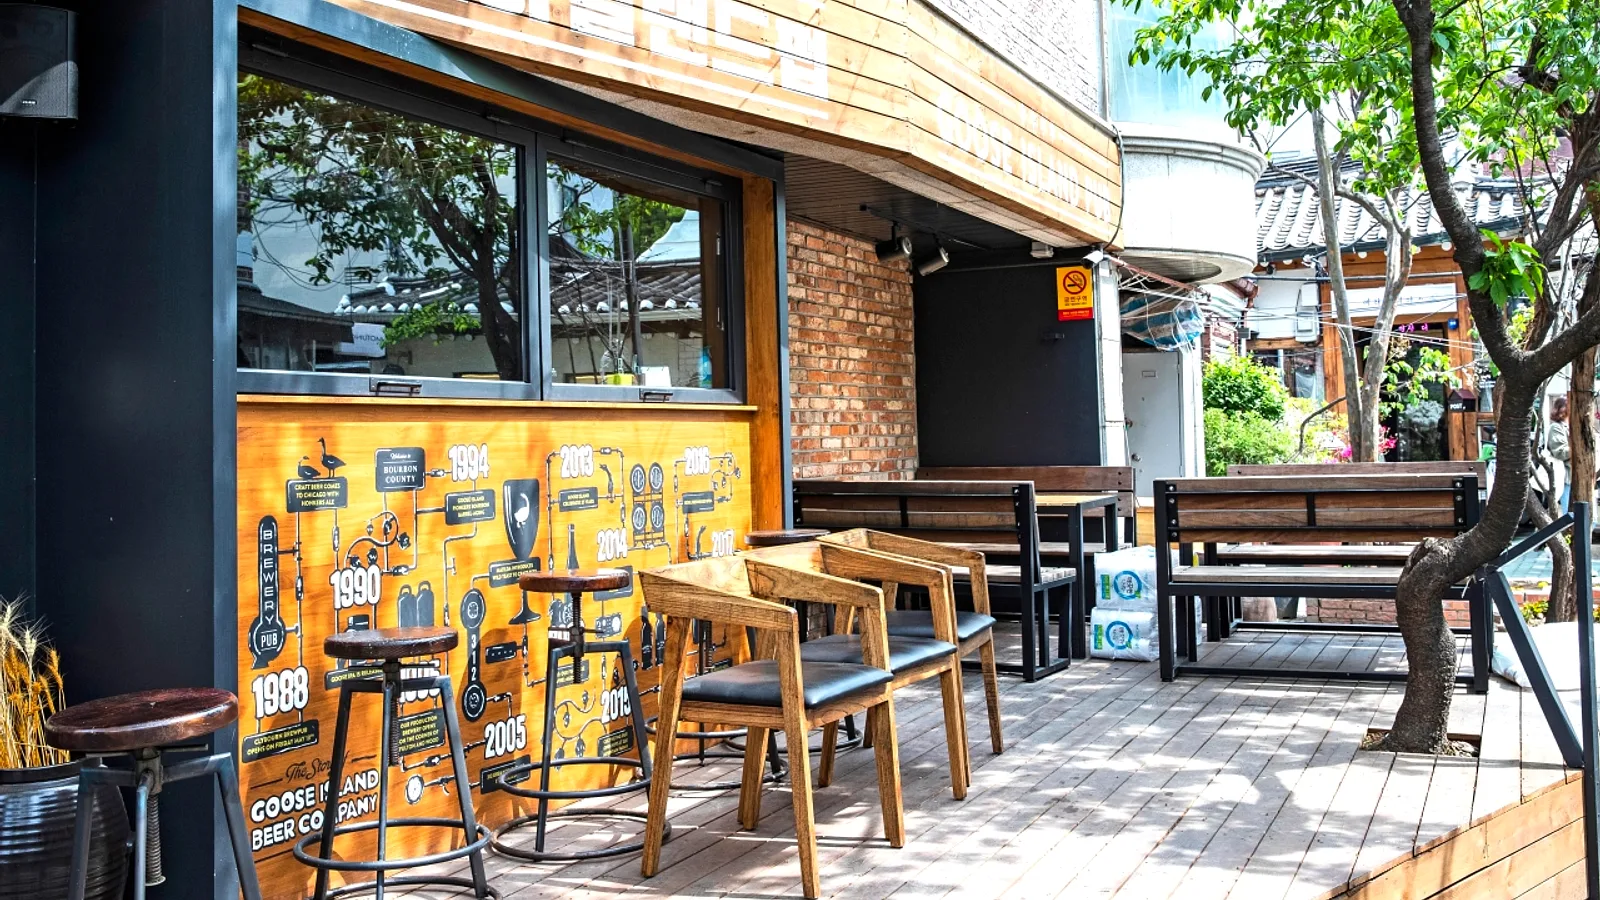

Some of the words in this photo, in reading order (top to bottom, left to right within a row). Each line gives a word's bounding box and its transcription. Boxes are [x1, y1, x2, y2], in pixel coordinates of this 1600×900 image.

[936, 89, 1013, 173] GOOSE
[1020, 136, 1080, 207] ISLAND
[383, 465, 418, 474] BOURBON
[385, 475, 416, 484] COUNTY
[448, 443, 489, 481] 1994
[560, 444, 594, 478] 2013
[684, 446, 710, 476] 2016
[597, 528, 628, 562] 2014
[711, 529, 735, 557] 2017
[262, 530, 275, 624] BREWERY
[330, 564, 381, 609] 1990
[261, 632, 278, 648] PUB
[470, 634, 479, 682] 312
[252, 667, 309, 719] 1988
[601, 687, 632, 723] 2015
[484, 715, 527, 759] 2005
[286, 761, 307, 784] The
[251, 784, 316, 822] GOOSE
[320, 769, 380, 803] ISAND
[252, 818, 295, 850] BEER
[299, 796, 378, 836] COPANY
